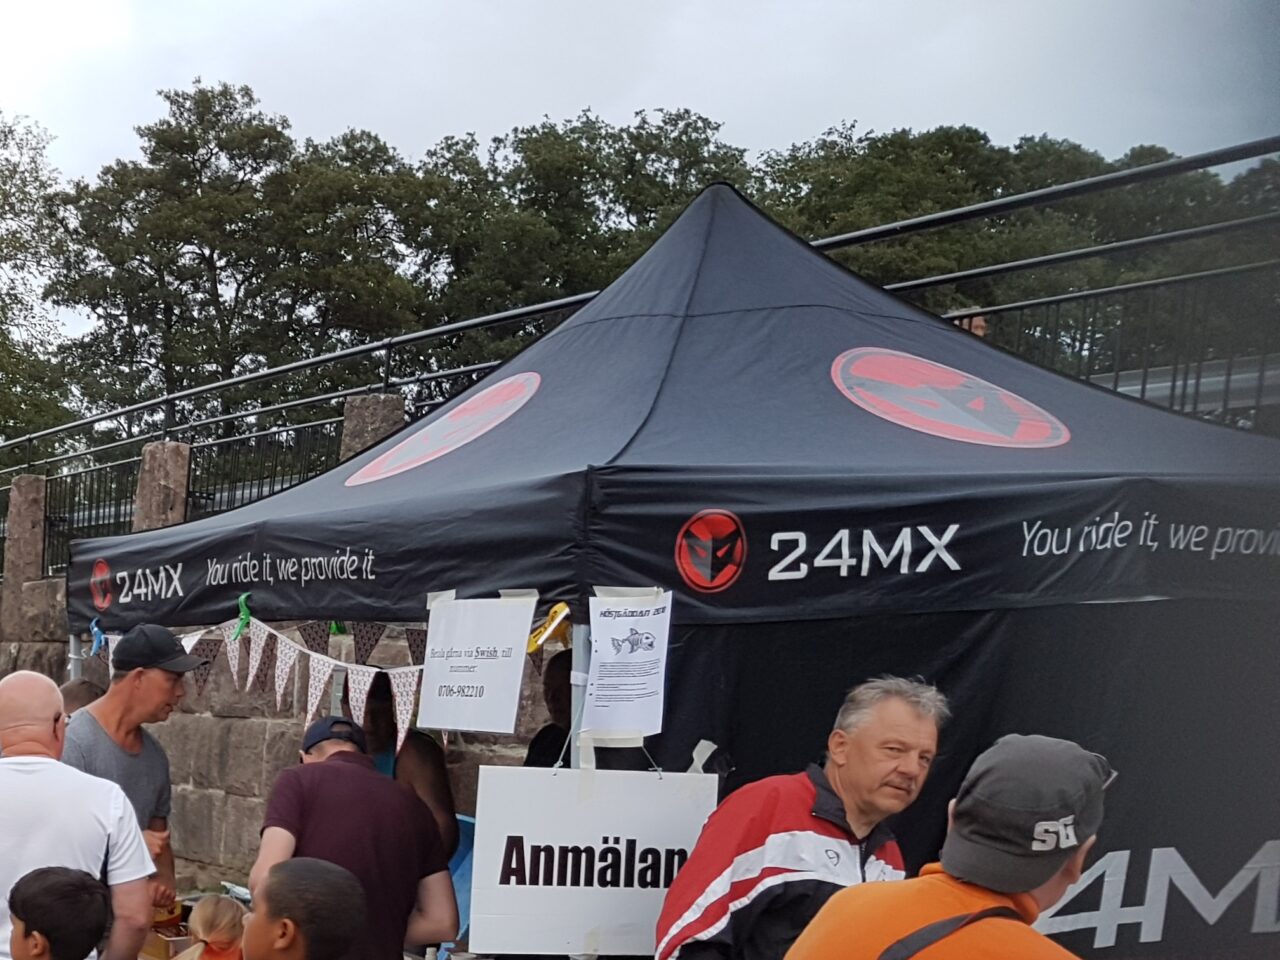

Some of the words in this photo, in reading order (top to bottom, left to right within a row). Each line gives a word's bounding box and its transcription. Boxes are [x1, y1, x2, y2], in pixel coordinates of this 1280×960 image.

[115, 562, 185, 604] 24MX
[206, 557, 230, 586] You
[231, 552, 260, 583] ride
[276, 557, 300, 582] we
[301, 546, 358, 587] provide
[362, 548, 376, 580] it
[767, 523, 962, 581] 24MX
[1021, 520, 1070, 558] You
[1078, 511, 1131, 553] ride
[1138, 511, 1161, 552] it,
[1168, 523, 1209, 552] we
[1209, 521, 1280, 562] provi
[438, 684, 485, 698] 0706-982210
